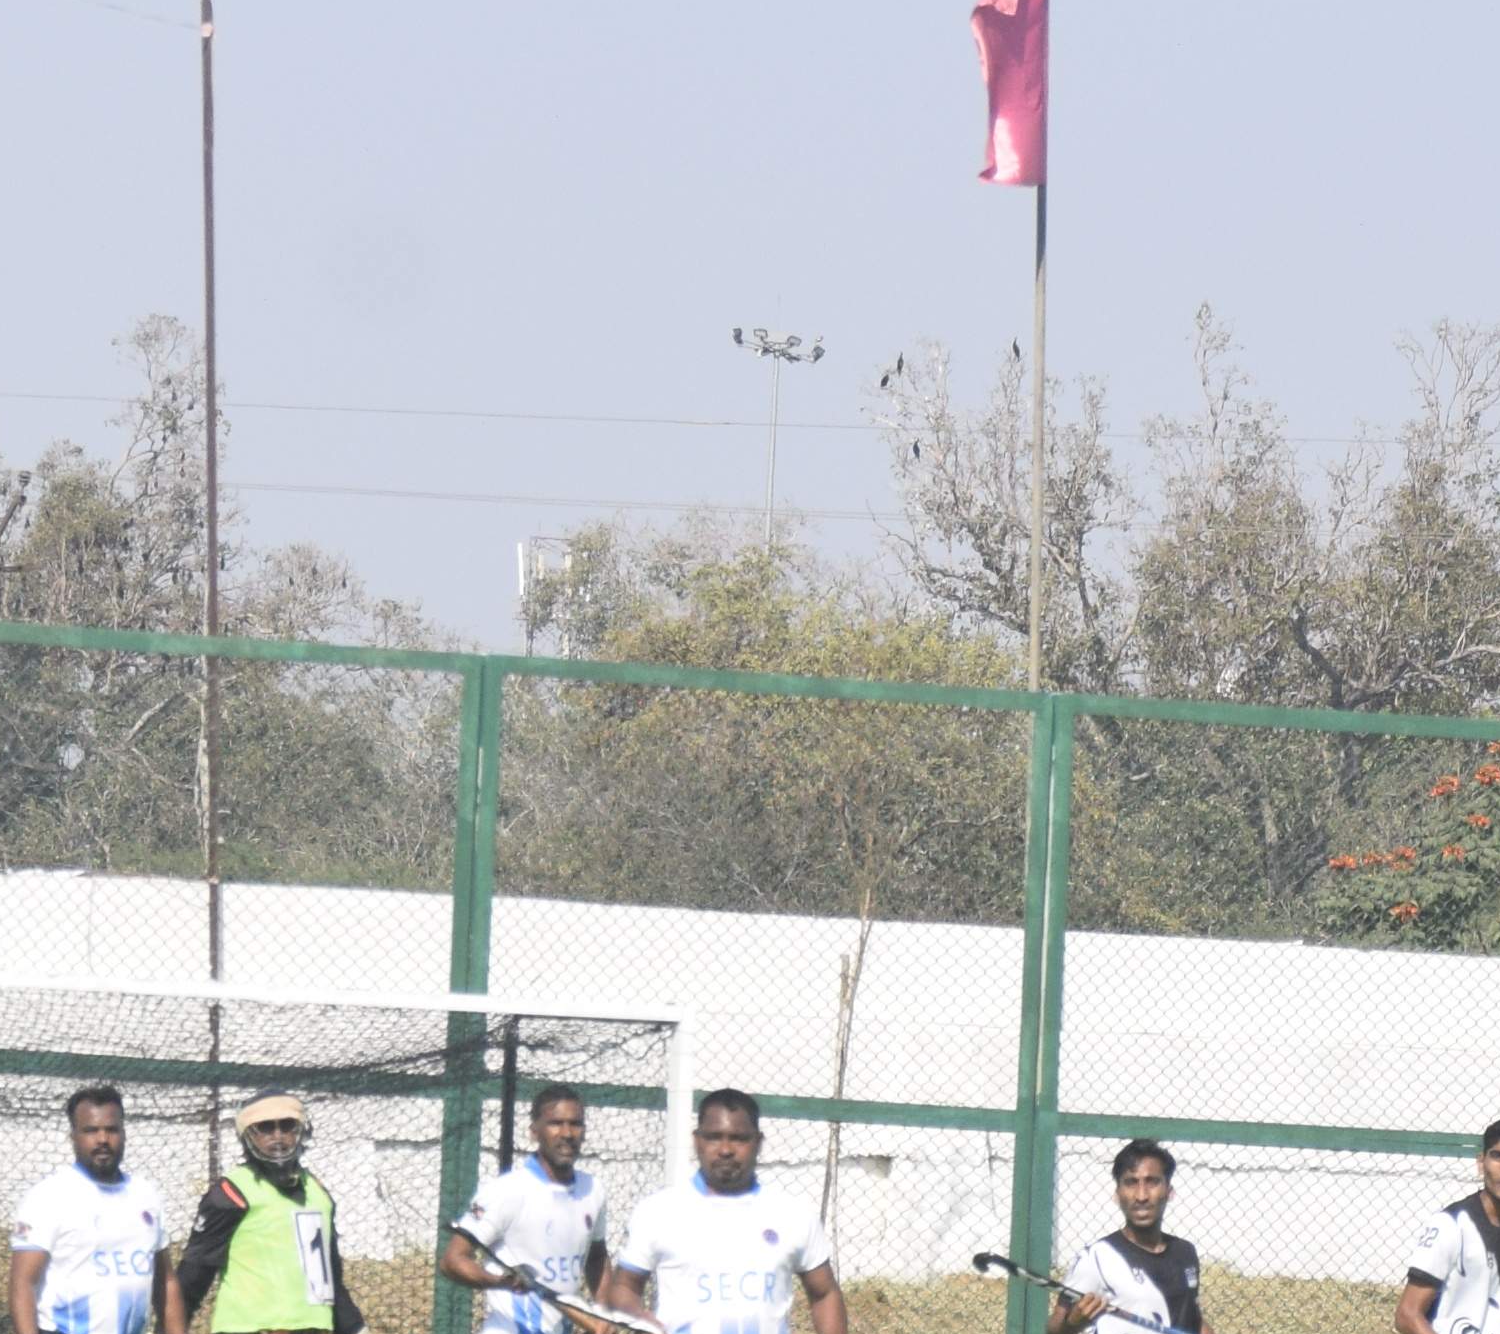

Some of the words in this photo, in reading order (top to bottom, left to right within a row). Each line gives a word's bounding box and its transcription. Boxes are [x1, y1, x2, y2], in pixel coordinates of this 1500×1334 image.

[310, 1227, 329, 1286] 1
[543, 1255, 585, 1283] SEC
[697, 1270, 776, 1304] SECR
